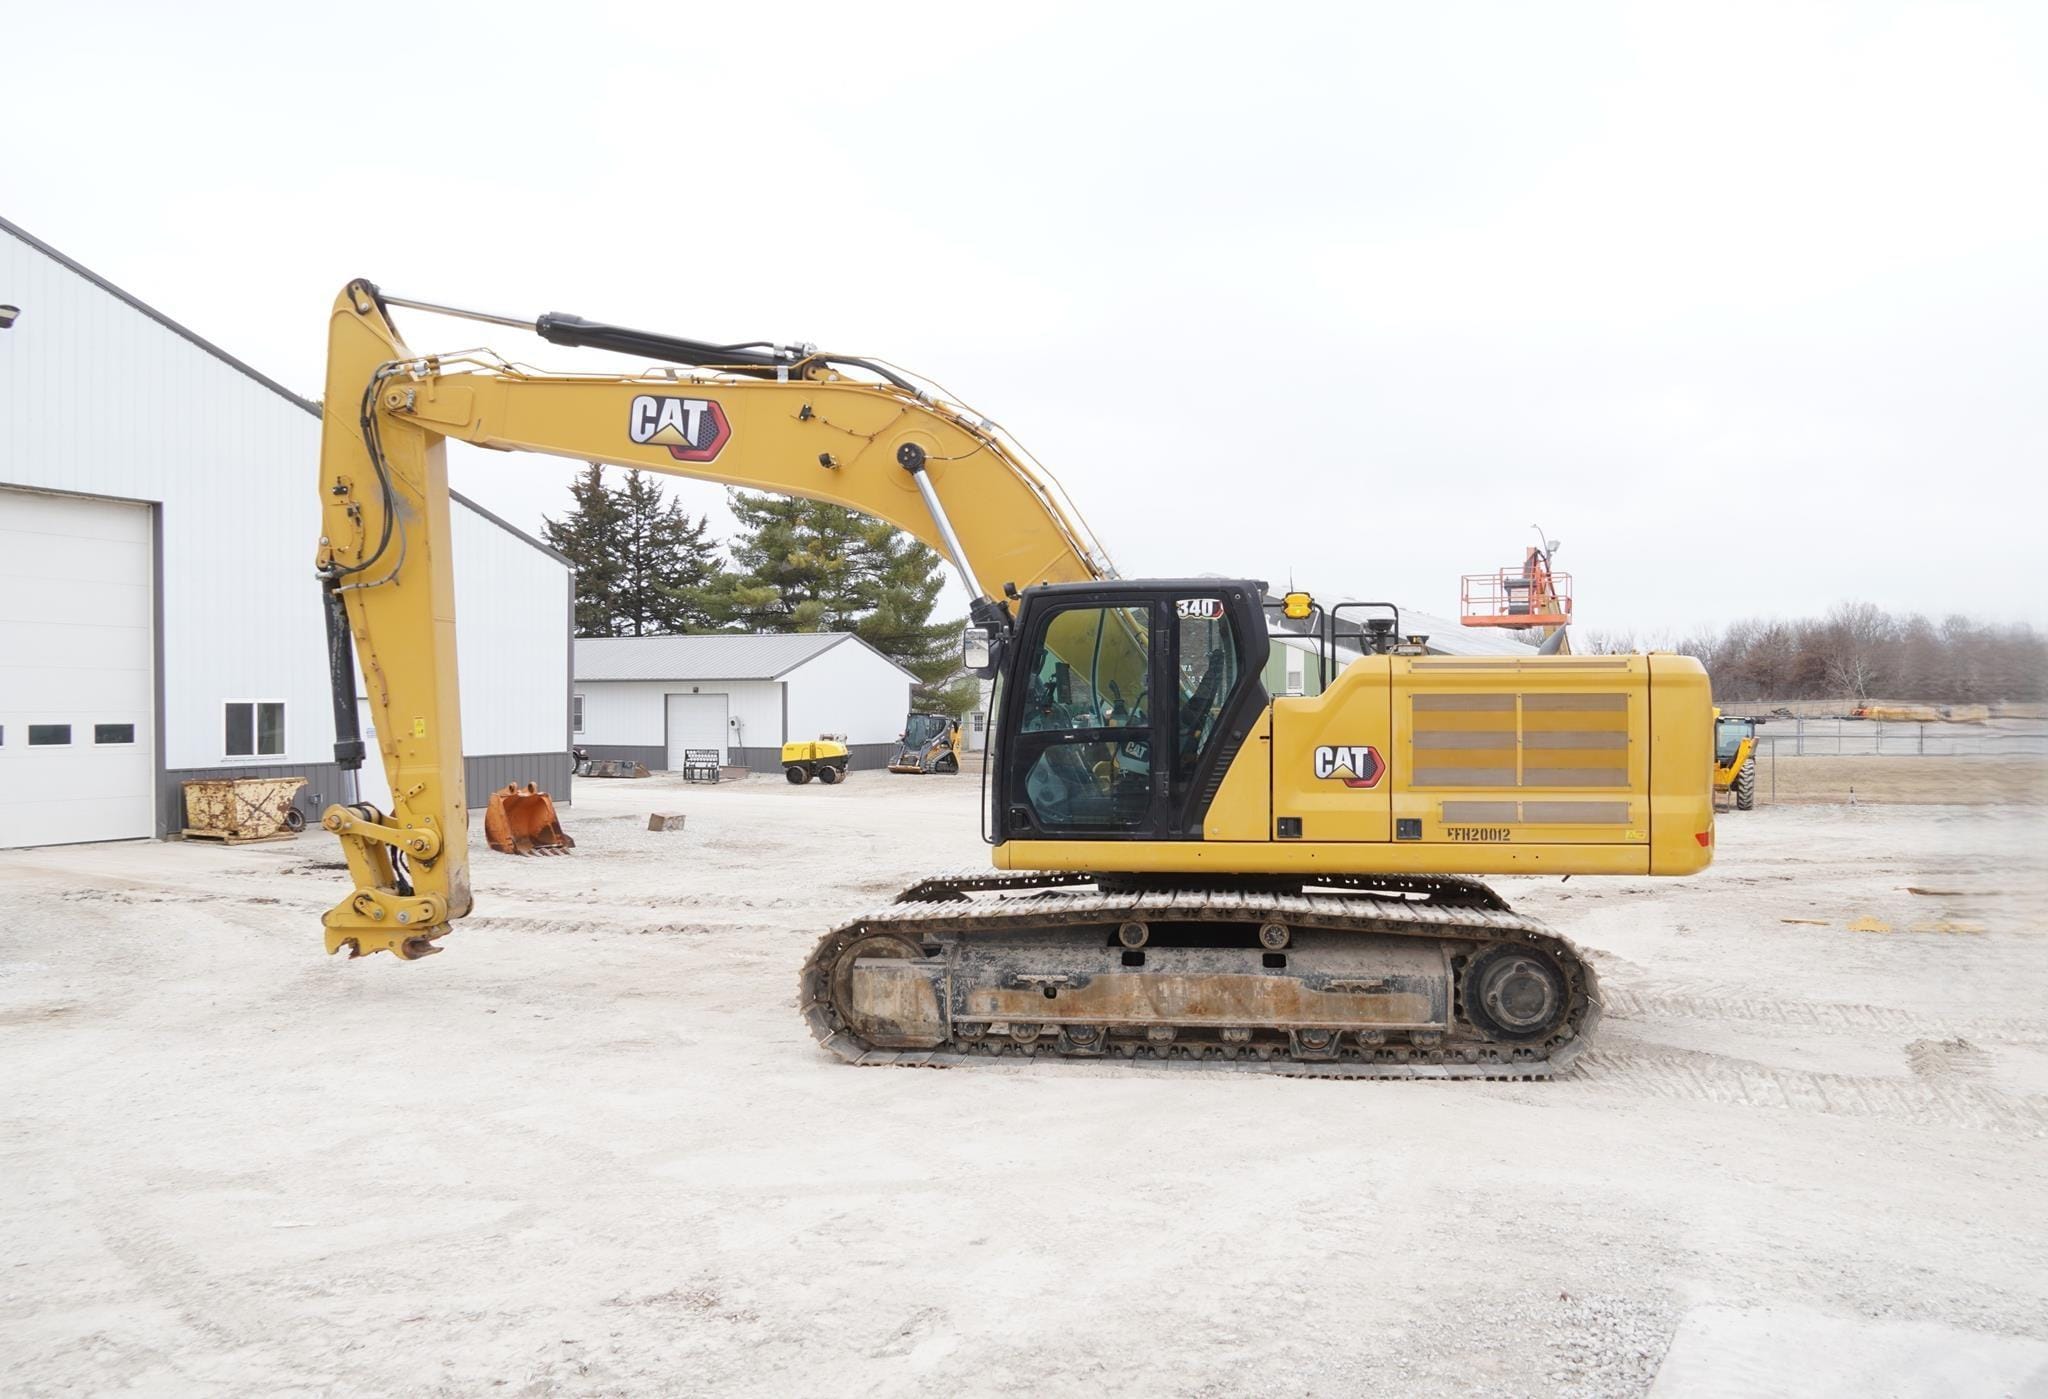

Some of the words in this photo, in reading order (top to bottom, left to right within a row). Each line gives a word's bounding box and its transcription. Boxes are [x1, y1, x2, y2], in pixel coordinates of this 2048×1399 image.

[630, 396, 709, 447] CAT
[1176, 599, 1213, 617] 340
[1125, 741, 1148, 759] CAT
[1315, 746, 1369, 779] CAT
